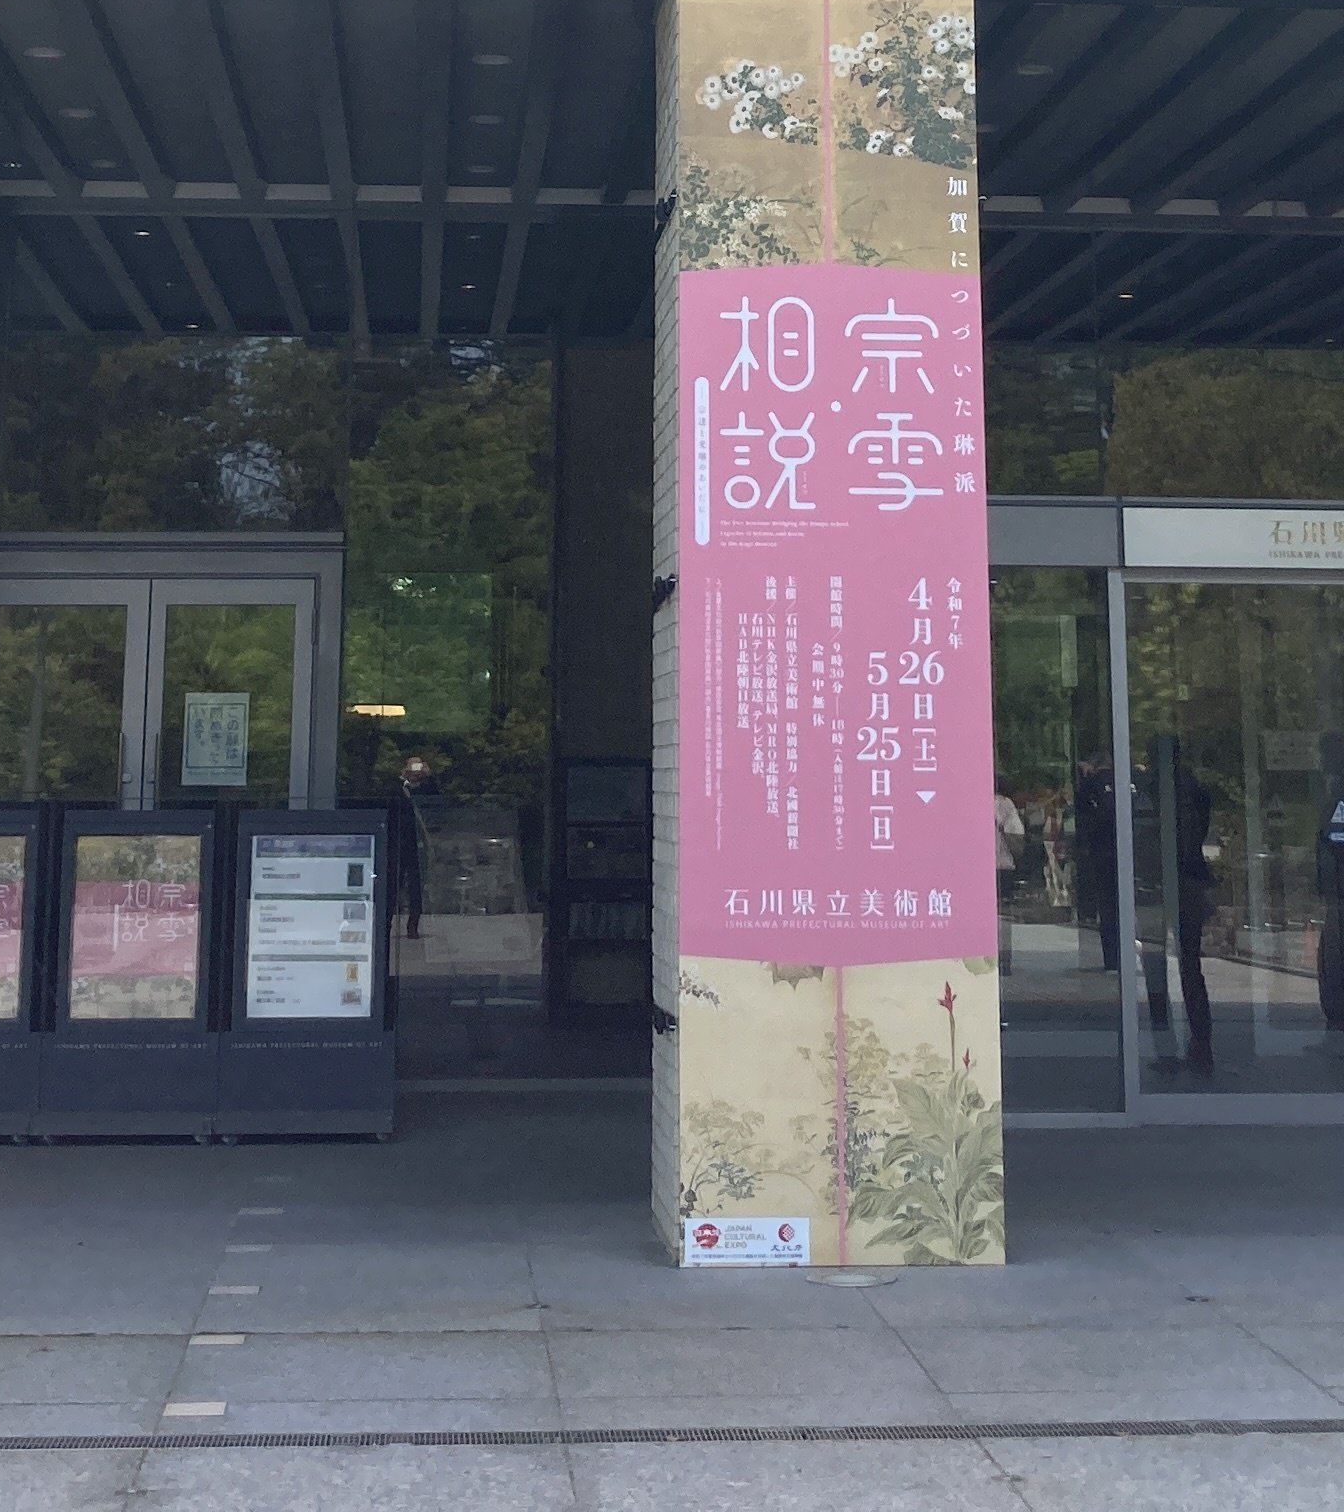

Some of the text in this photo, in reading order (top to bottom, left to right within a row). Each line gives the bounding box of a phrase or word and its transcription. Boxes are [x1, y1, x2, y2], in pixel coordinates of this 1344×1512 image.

[946, 176, 976, 494] 加賀につづいた琳派
[843, 298, 945, 511] 宗雪
[1268, 550, 1321, 559] ISHIKAWA
[946, 576, 964, 651] 令和7年
[811, 641, 825, 727] 会期中無休
[724, 888, 953, 917] 石川県立美術館
[724, 919, 950, 930] ISHIKAWA PREFECTURAL MUSEUM OF ART
[724, 1224, 753, 1232] JAPAN
[724, 1233, 767, 1241] CULTURAL
[724, 1241, 748, 1249] EXPO
